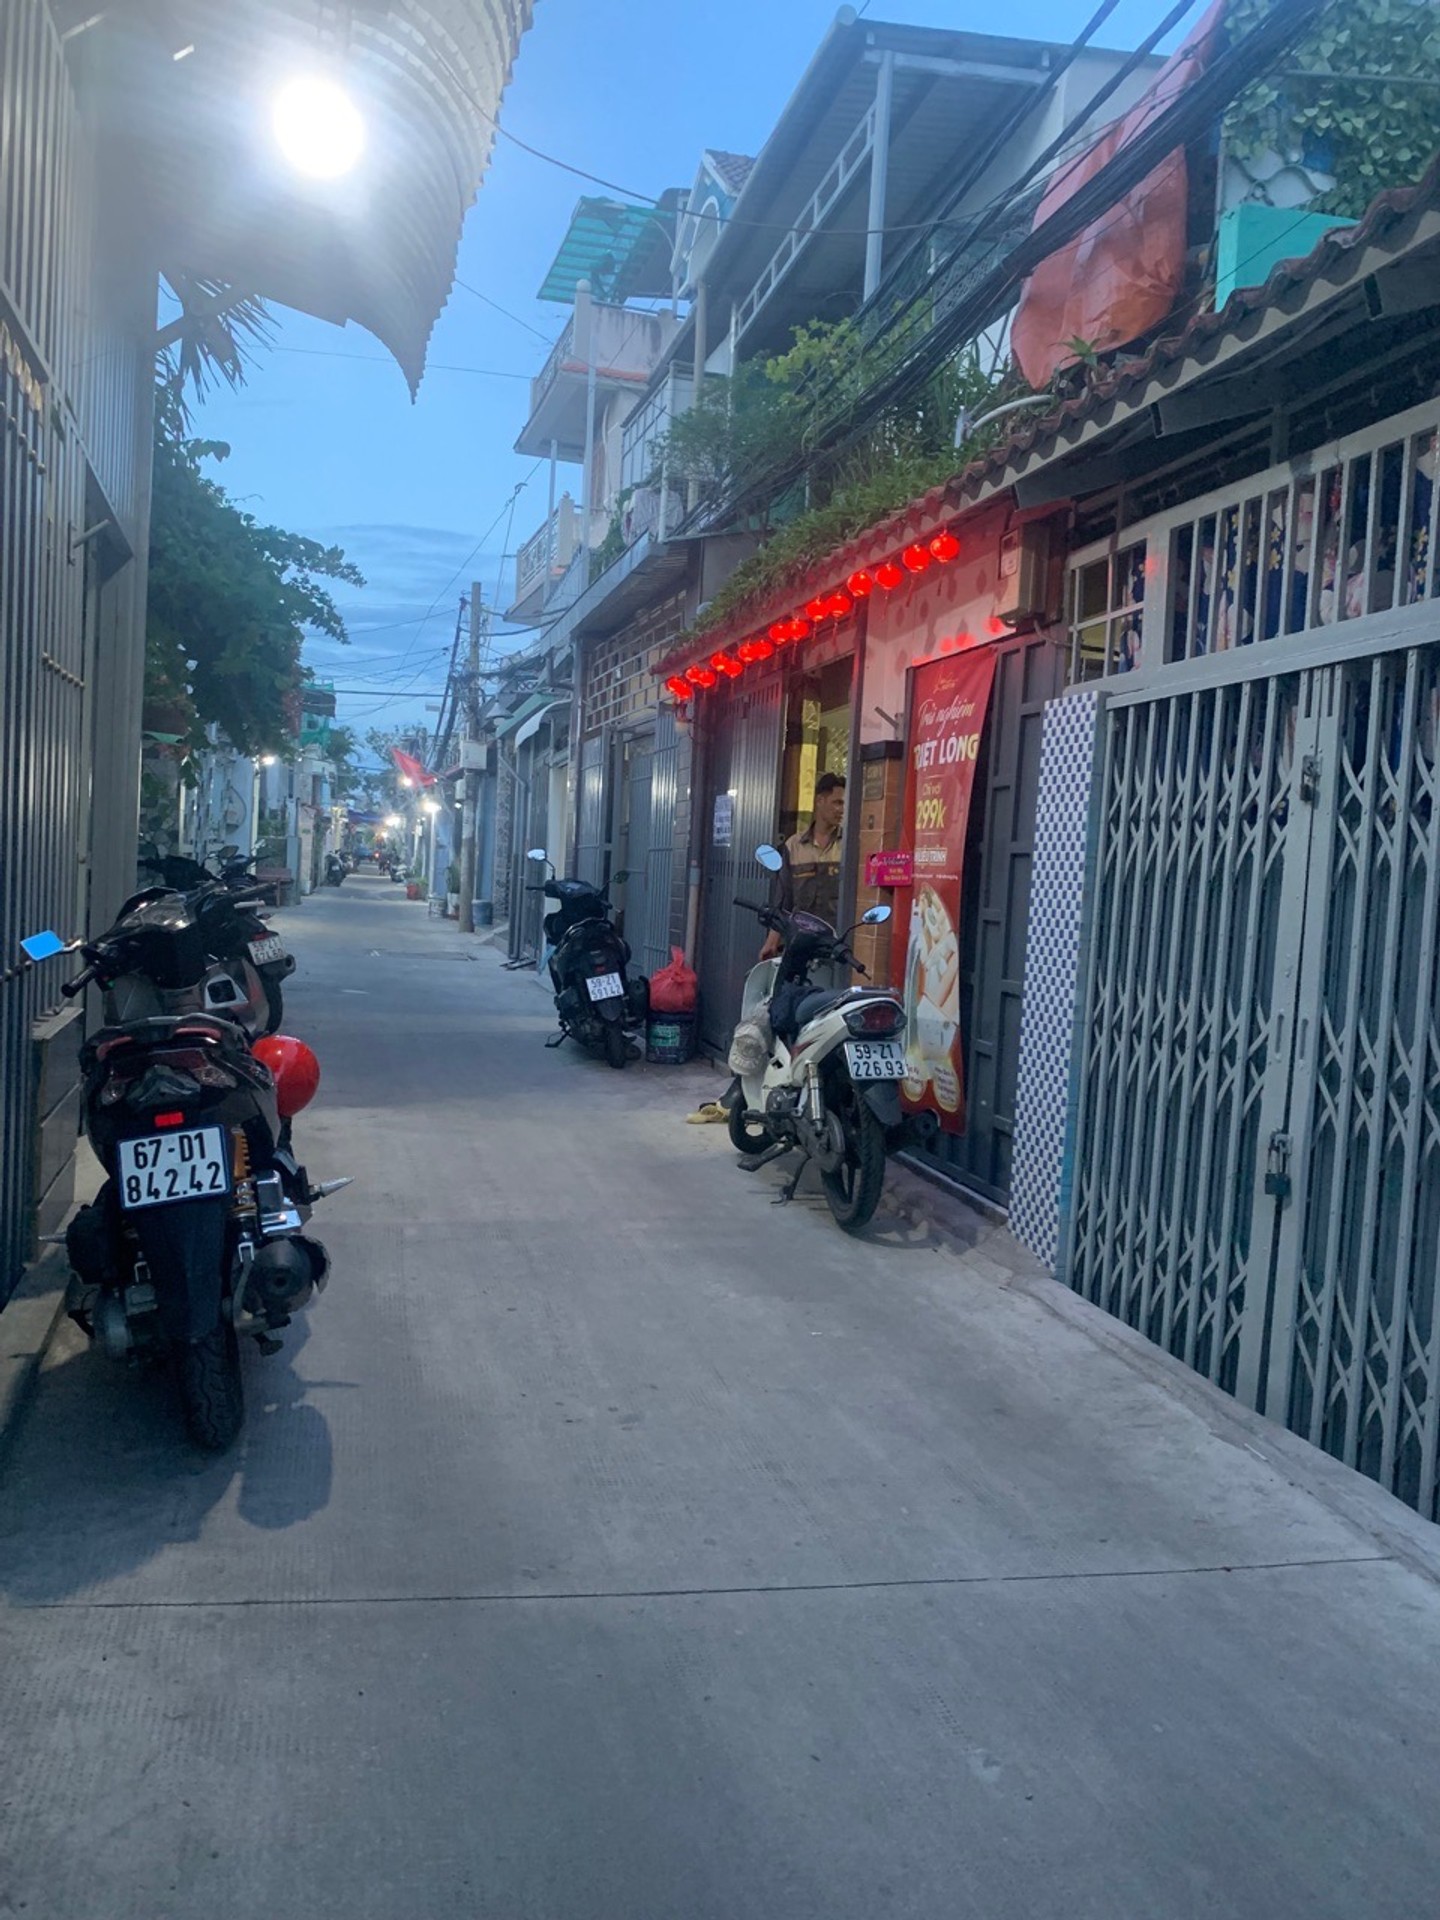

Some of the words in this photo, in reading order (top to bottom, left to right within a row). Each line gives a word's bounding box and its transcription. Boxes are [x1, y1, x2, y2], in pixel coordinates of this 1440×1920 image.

[855, 1043, 894, 1059] 59-Z1
[853, 1060, 905, 1077] 226.93
[133, 1132, 206, 1170] 67-D1
[126, 1161, 223, 1204] 842.42
